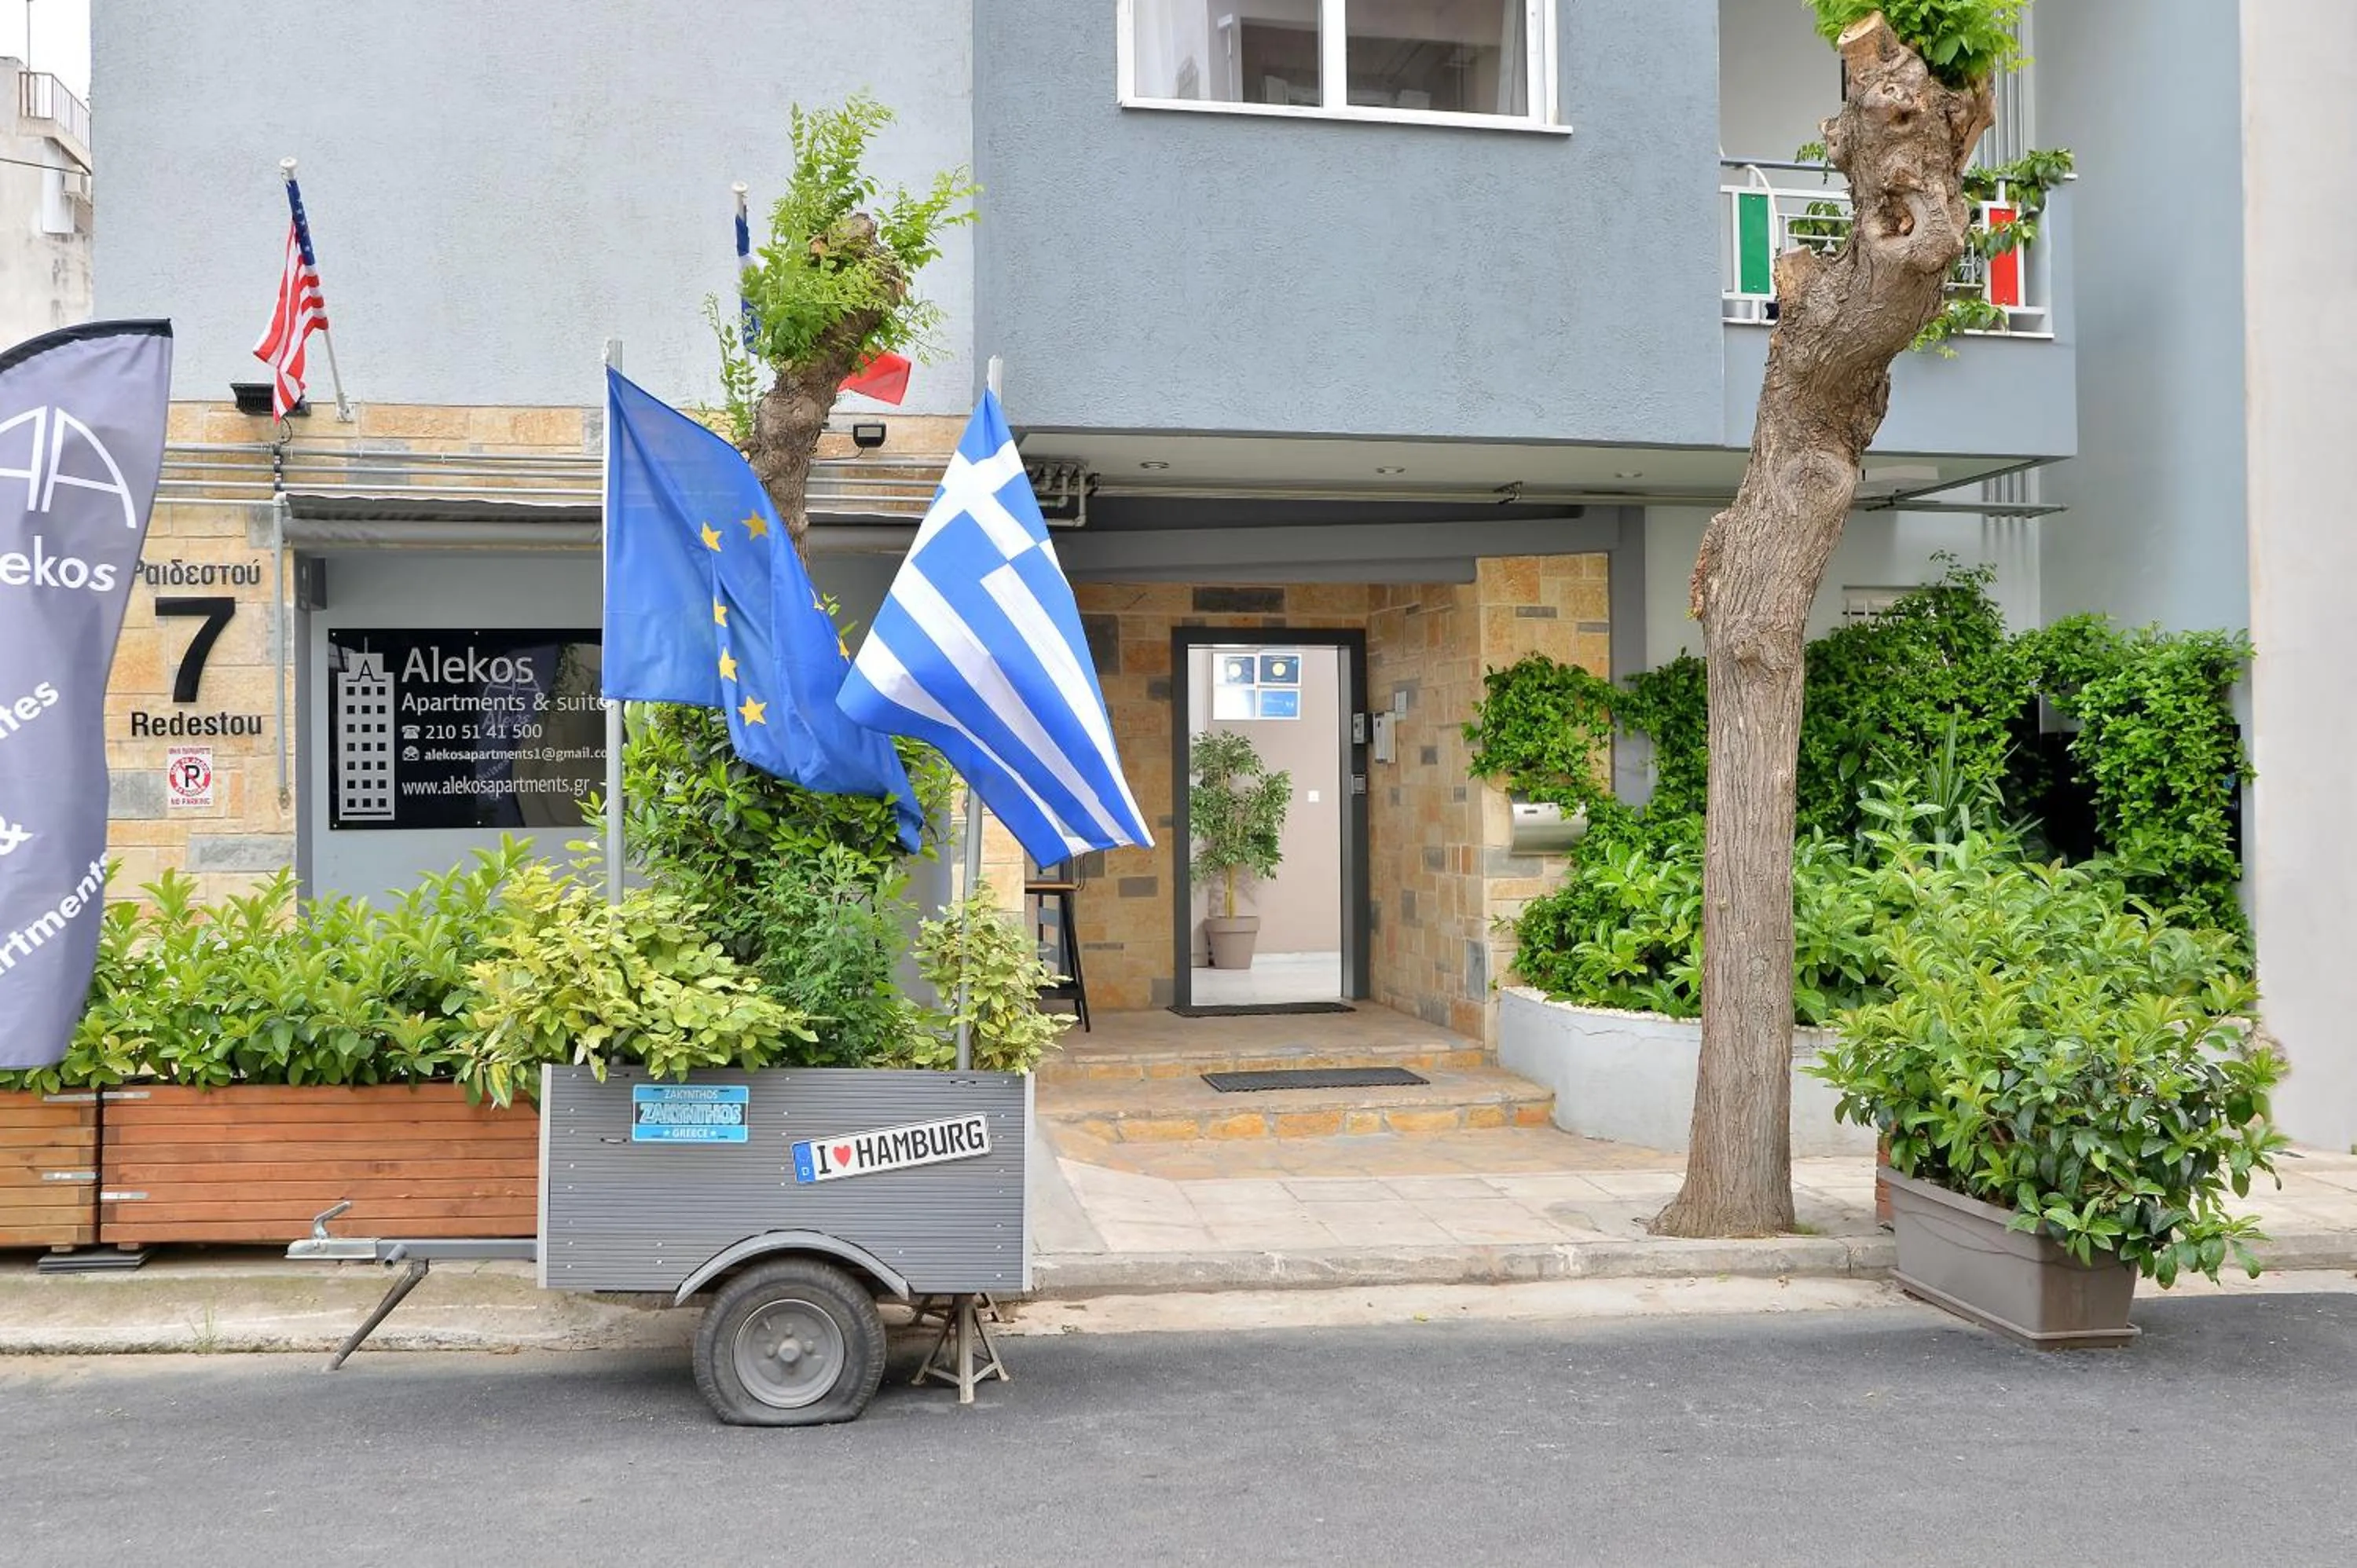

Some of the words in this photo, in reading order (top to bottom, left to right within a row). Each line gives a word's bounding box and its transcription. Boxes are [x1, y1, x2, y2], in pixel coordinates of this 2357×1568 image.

[156, 597, 236, 702] 7
[401, 646, 534, 683] Alekos
[0, 681, 59, 739] tes
[401, 692, 526, 716] Apartments
[533, 692, 551, 711] &
[131, 712, 262, 736] Redestou
[425, 724, 456, 739] 210
[461, 724, 482, 739] 51
[486, 724, 507, 739] 41
[512, 724, 543, 739] 500
[401, 775, 590, 798] www.alekosapartments.gr
[664, 1090, 718, 1100] ZAKYNTHOS
[639, 1102, 742, 1124] ZAKYNTHOS
[672, 1127, 709, 1138] GREECE
[817, 1145, 831, 1174] I
[856, 1119, 984, 1167] HAMBURG
